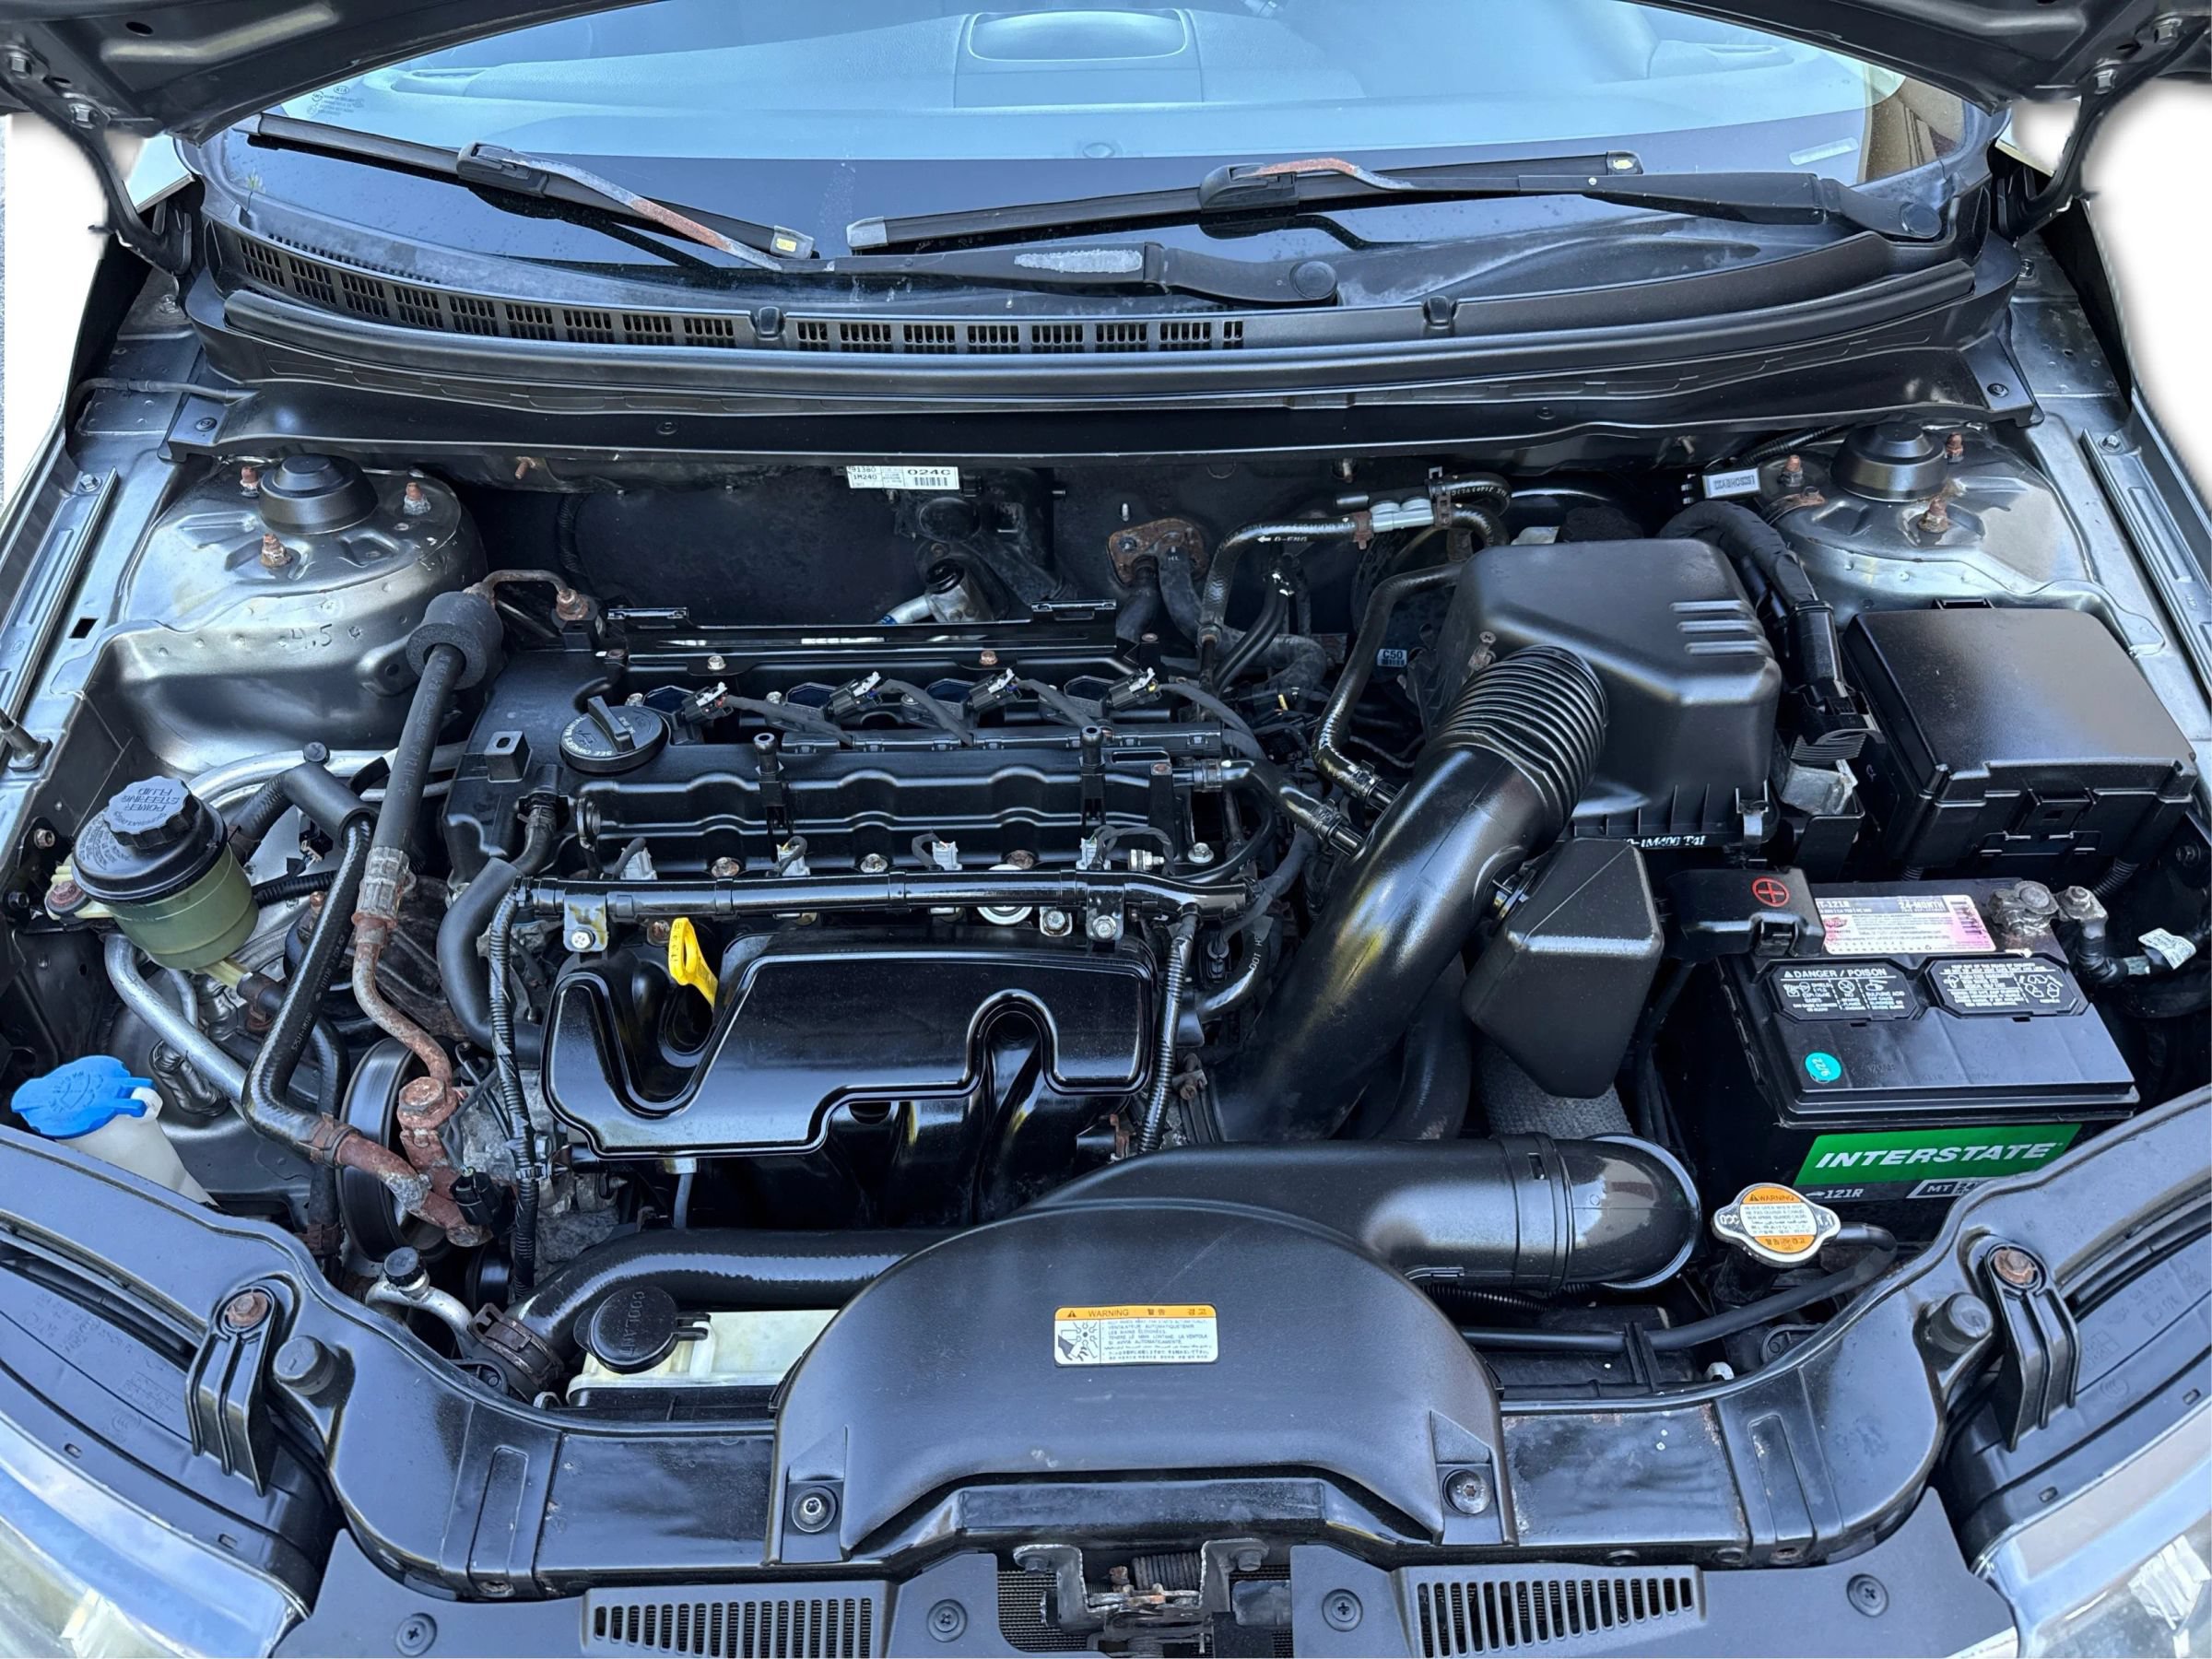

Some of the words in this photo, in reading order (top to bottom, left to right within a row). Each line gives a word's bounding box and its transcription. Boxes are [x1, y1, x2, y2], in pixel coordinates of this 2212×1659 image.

[1382, 650, 1404, 660] C50
[121, 795, 181, 805] STEERING
[124, 803, 167, 812] POWER
[1793, 970, 1838, 978] DANGER
[1847, 968, 1888, 977] POISON
[1815, 1142, 2057, 1169] INTERSTATE
[1824, 1188, 1865, 1199] 121R
[1926, 1184, 1953, 1193] MT
[1088, 1309, 1130, 1318] WARNING
[618, 1291, 645, 1358] COOLANT
